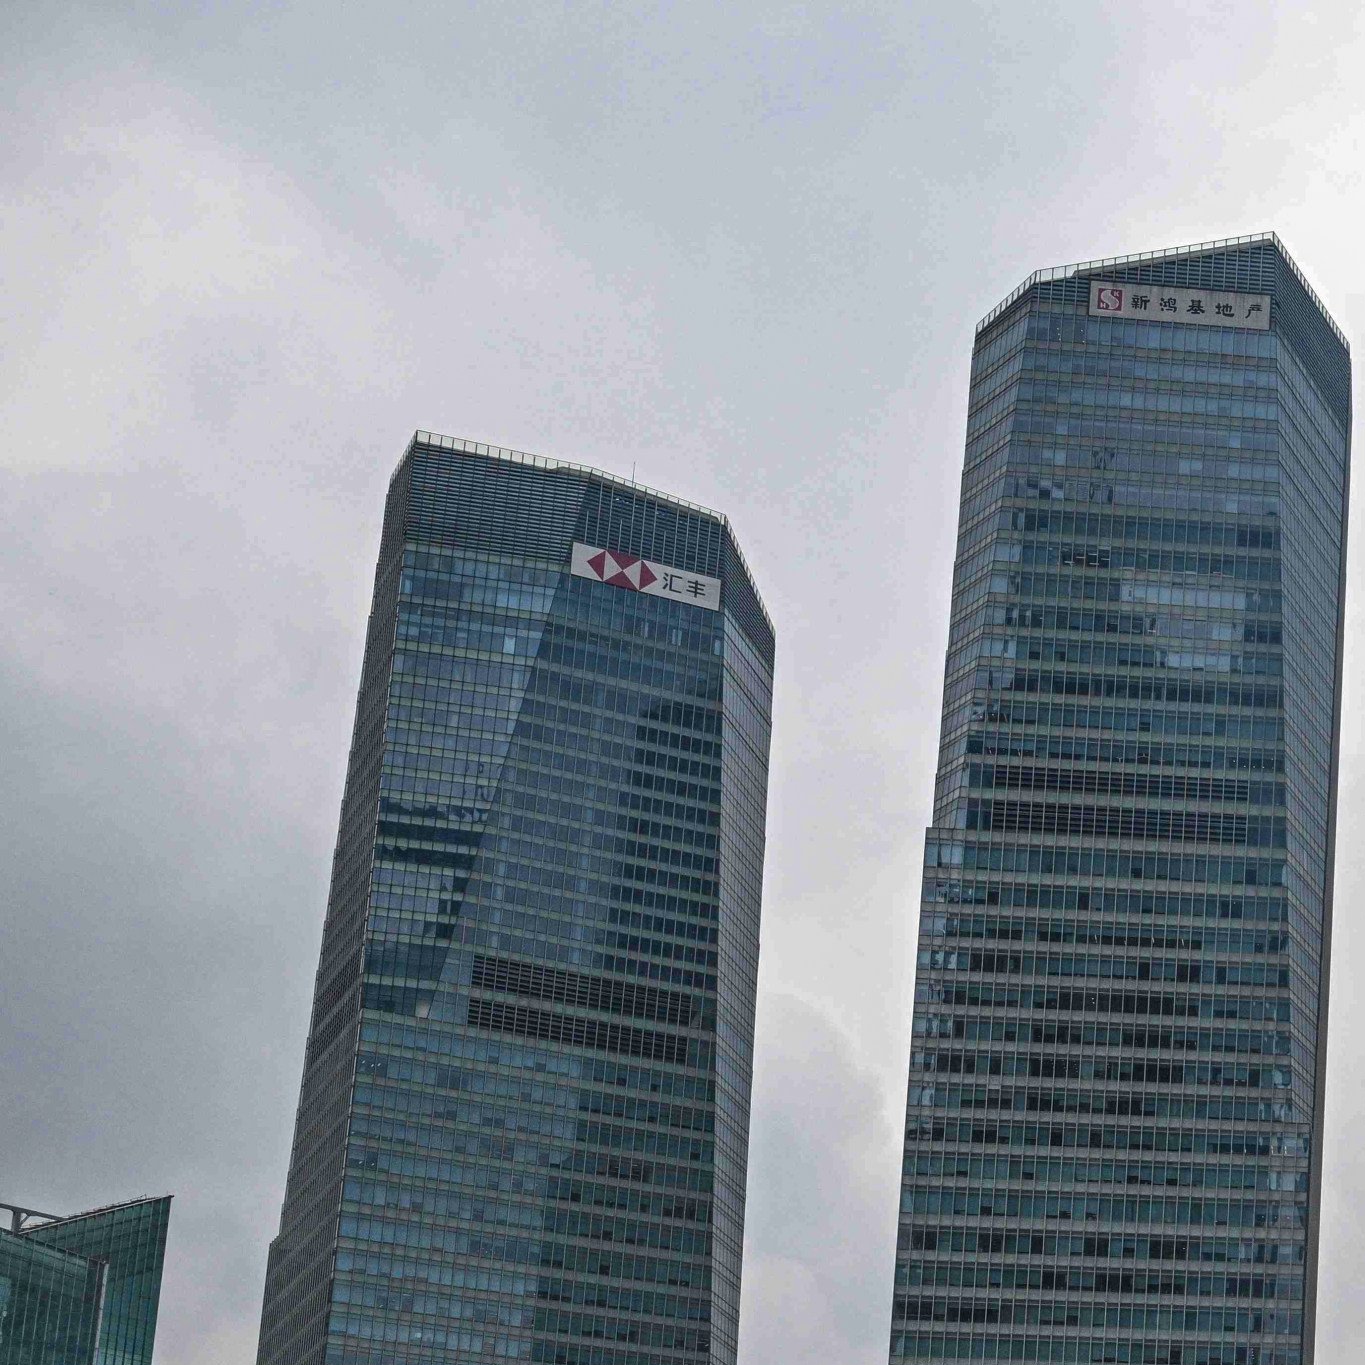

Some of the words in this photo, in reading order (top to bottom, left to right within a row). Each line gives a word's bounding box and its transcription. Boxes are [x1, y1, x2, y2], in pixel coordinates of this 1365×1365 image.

[1131, 294, 1263, 319] 新鸿基地产
[662, 572, 706, 598] 汇丰
